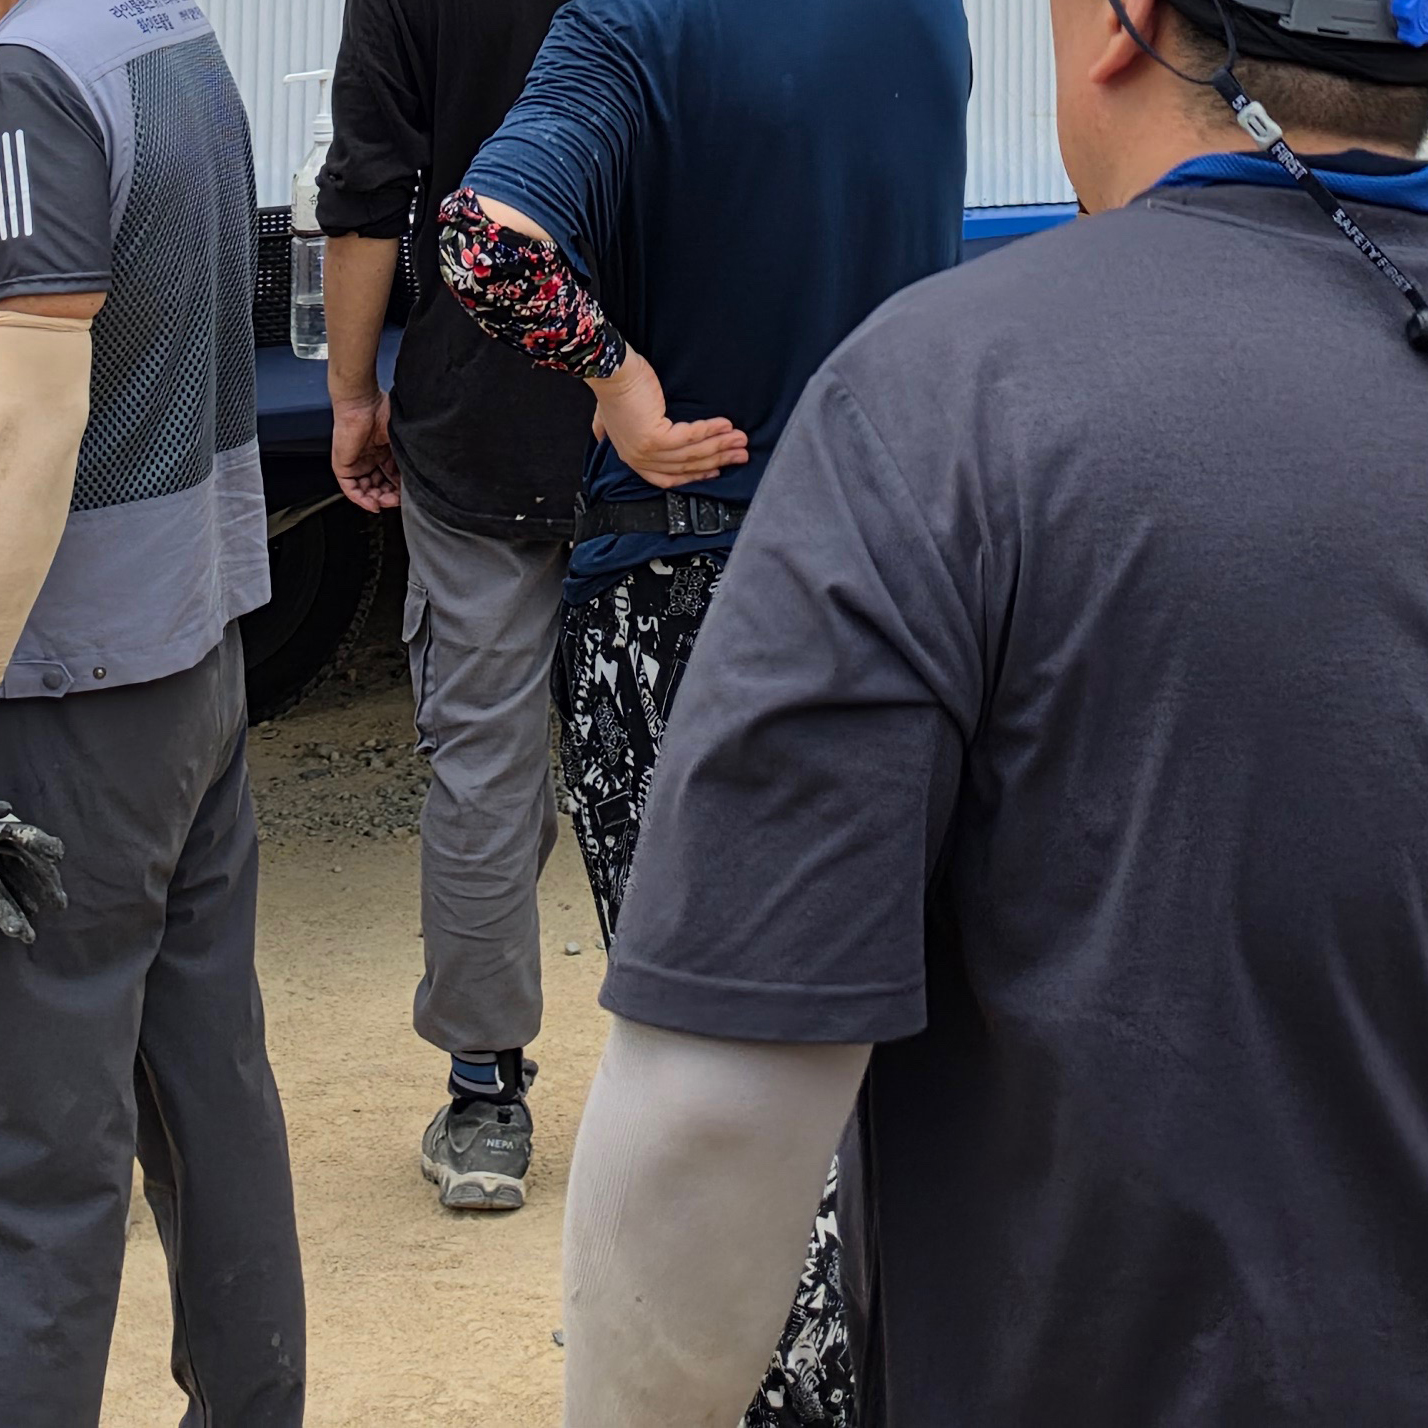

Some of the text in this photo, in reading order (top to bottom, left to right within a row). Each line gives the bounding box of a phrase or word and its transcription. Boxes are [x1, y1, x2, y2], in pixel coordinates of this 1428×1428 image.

[1272, 142, 1308, 181] FIRST
[1332, 208, 1382, 260] SAFETY
[1377, 257, 1413, 293] FIRST
[486, 1138, 514, 1150] NEPA
